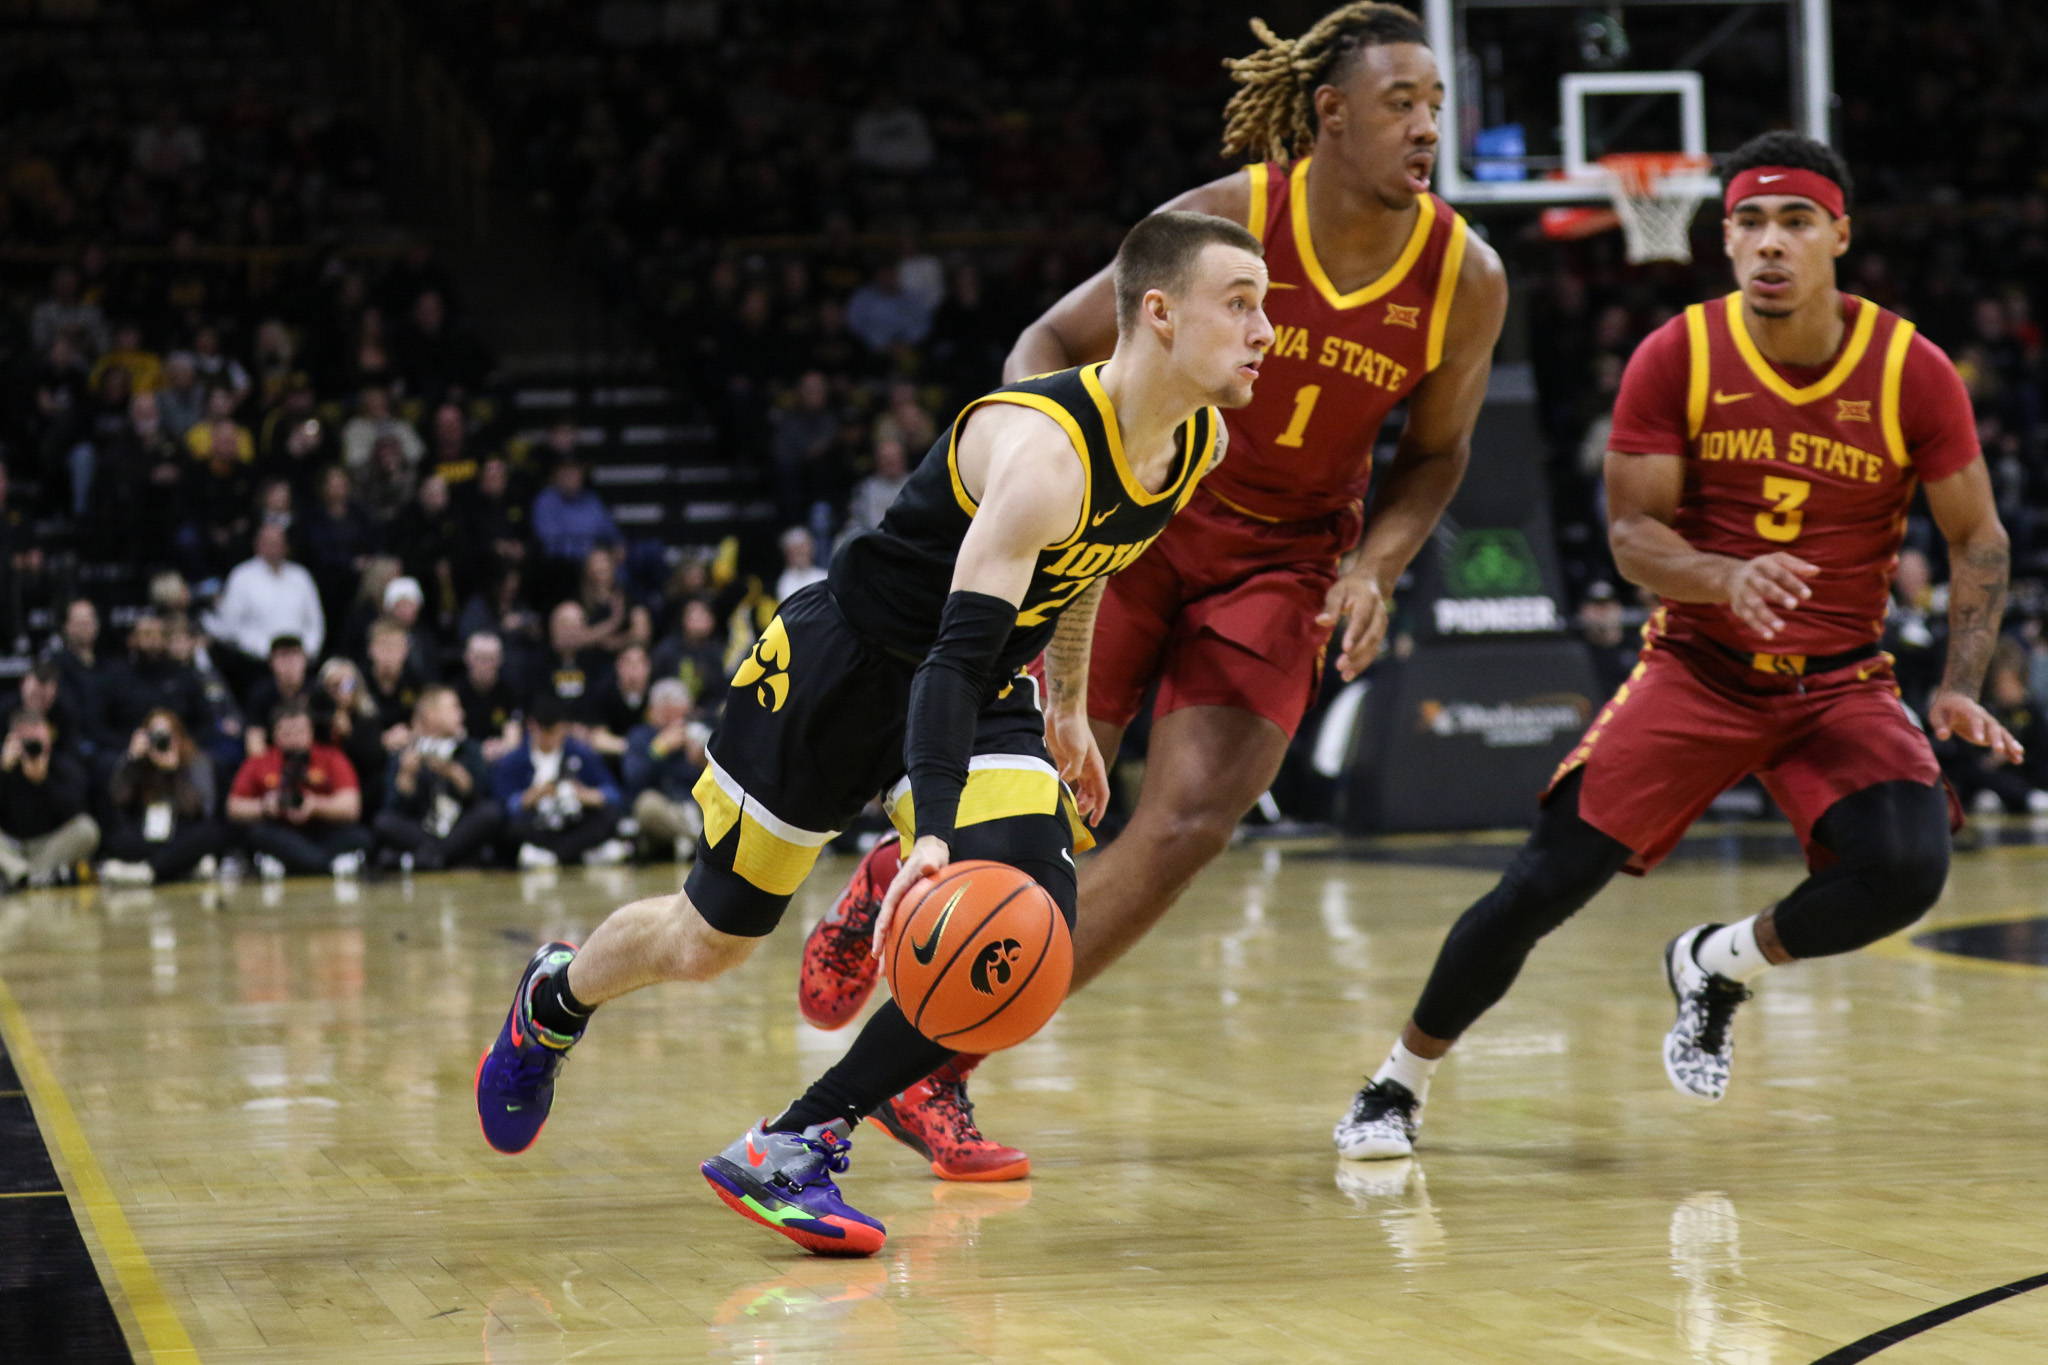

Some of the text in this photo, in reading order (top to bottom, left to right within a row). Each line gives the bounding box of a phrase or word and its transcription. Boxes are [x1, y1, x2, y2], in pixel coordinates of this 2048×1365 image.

[1261, 324, 1408, 392] WA STATE
[1274, 384, 1321, 448] 1
[1701, 428, 1884, 484] IOWA STATE
[1754, 475, 1811, 543] 3
[1042, 525, 1166, 577] IOW
